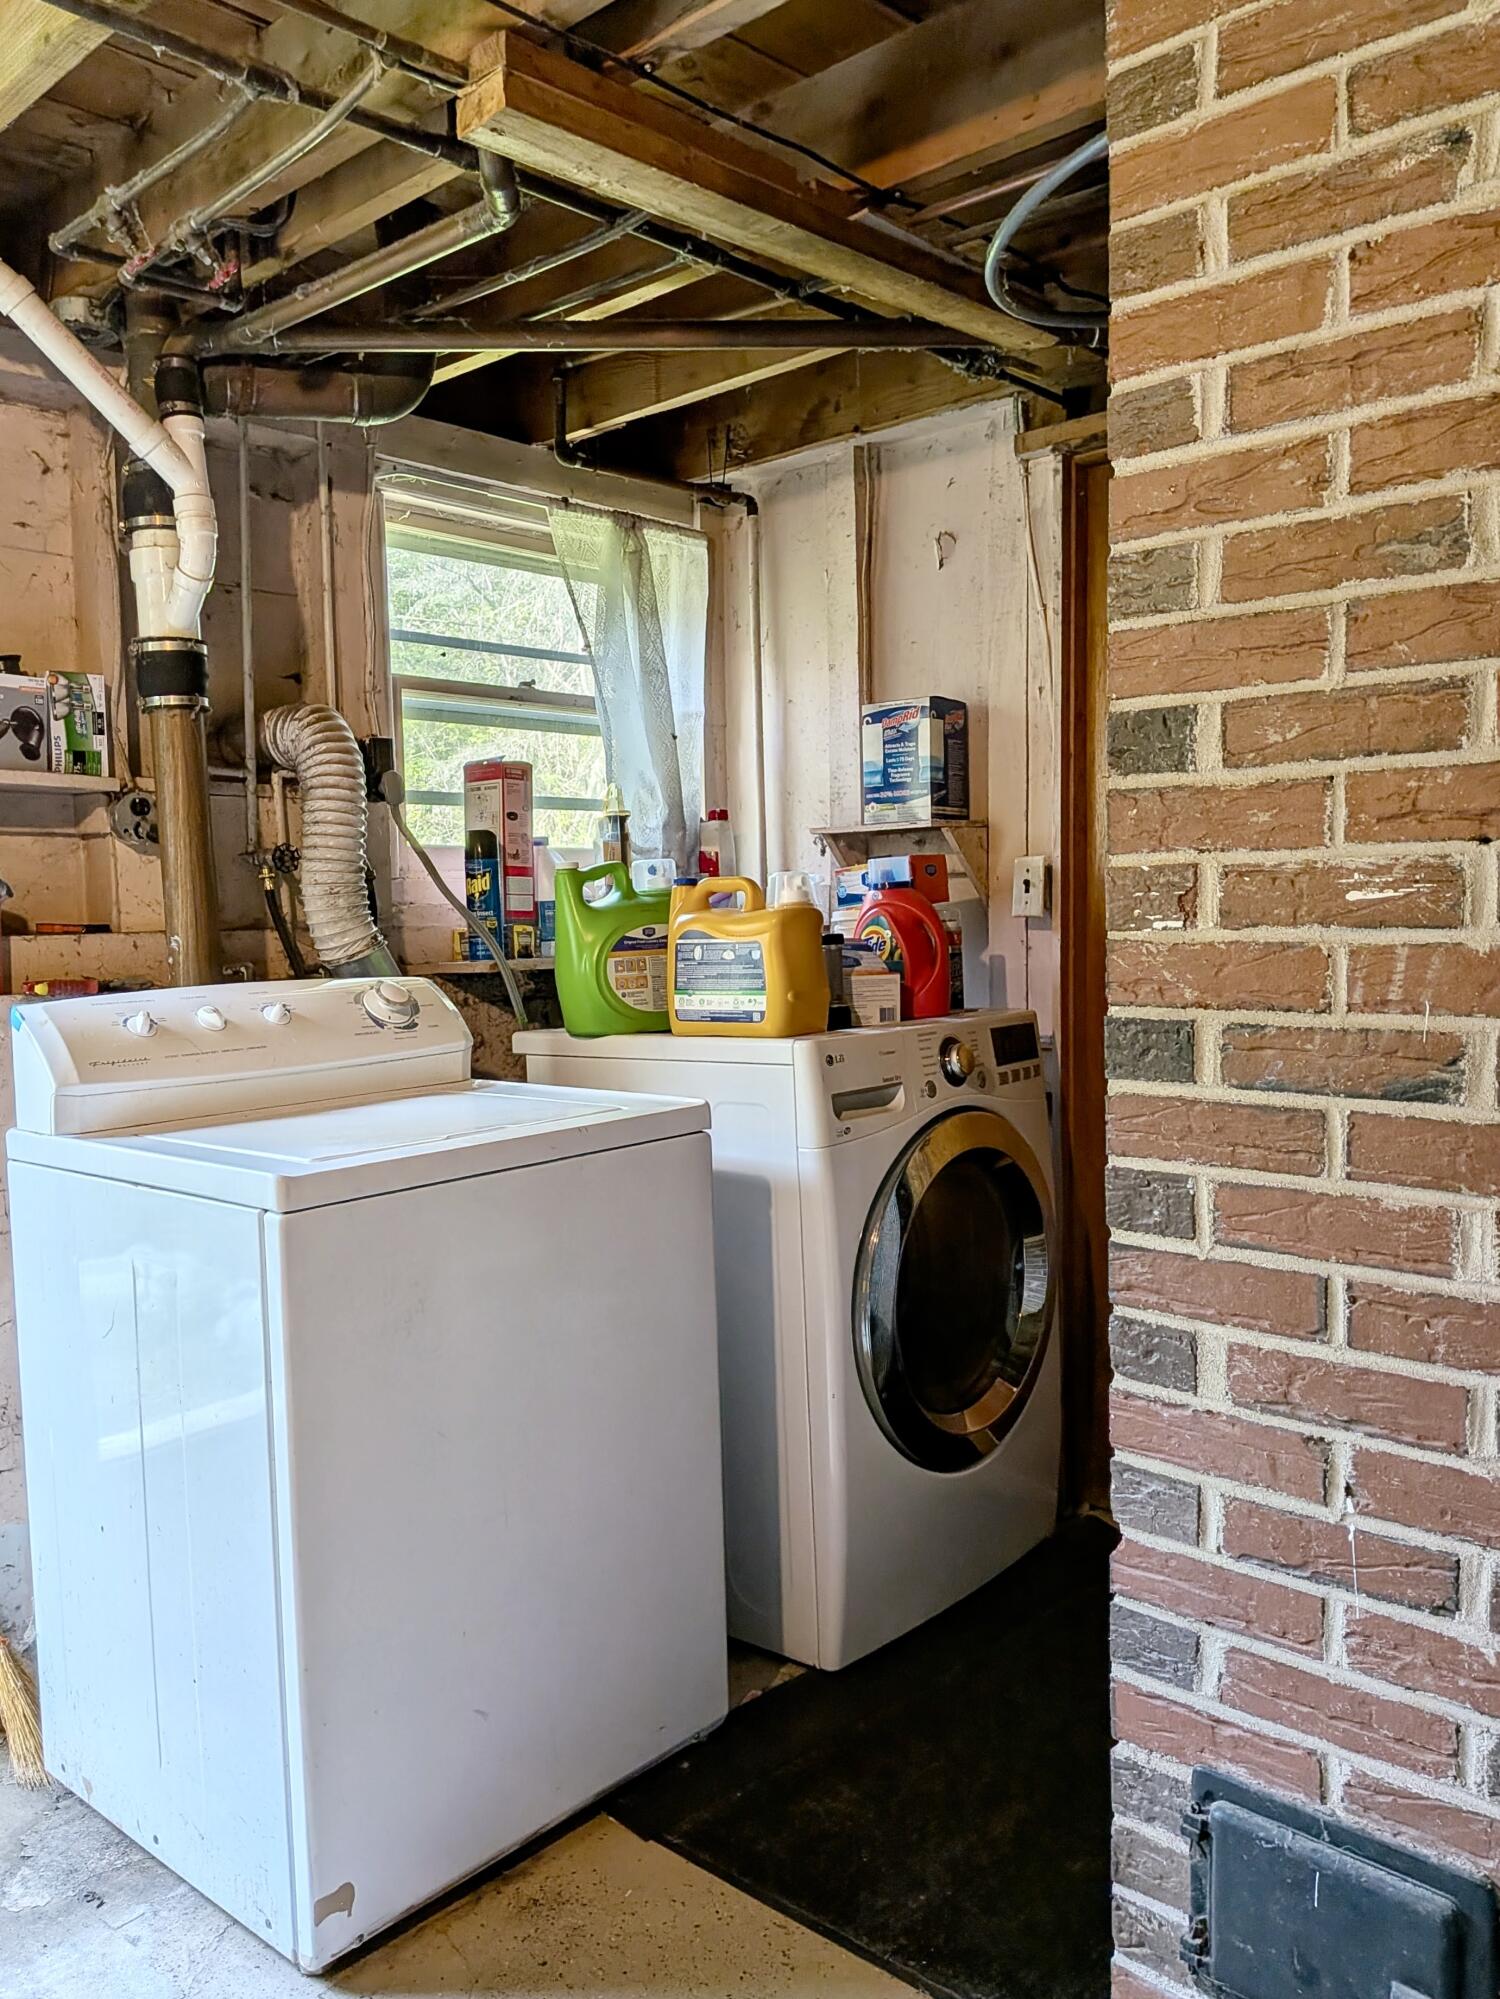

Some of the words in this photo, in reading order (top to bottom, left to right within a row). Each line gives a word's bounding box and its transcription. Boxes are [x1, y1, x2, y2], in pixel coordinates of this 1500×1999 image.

[881, 706, 921, 728] DampRid
[53, 735, 63, 773] PHILIPS
[466, 872, 491, 896] Raid
